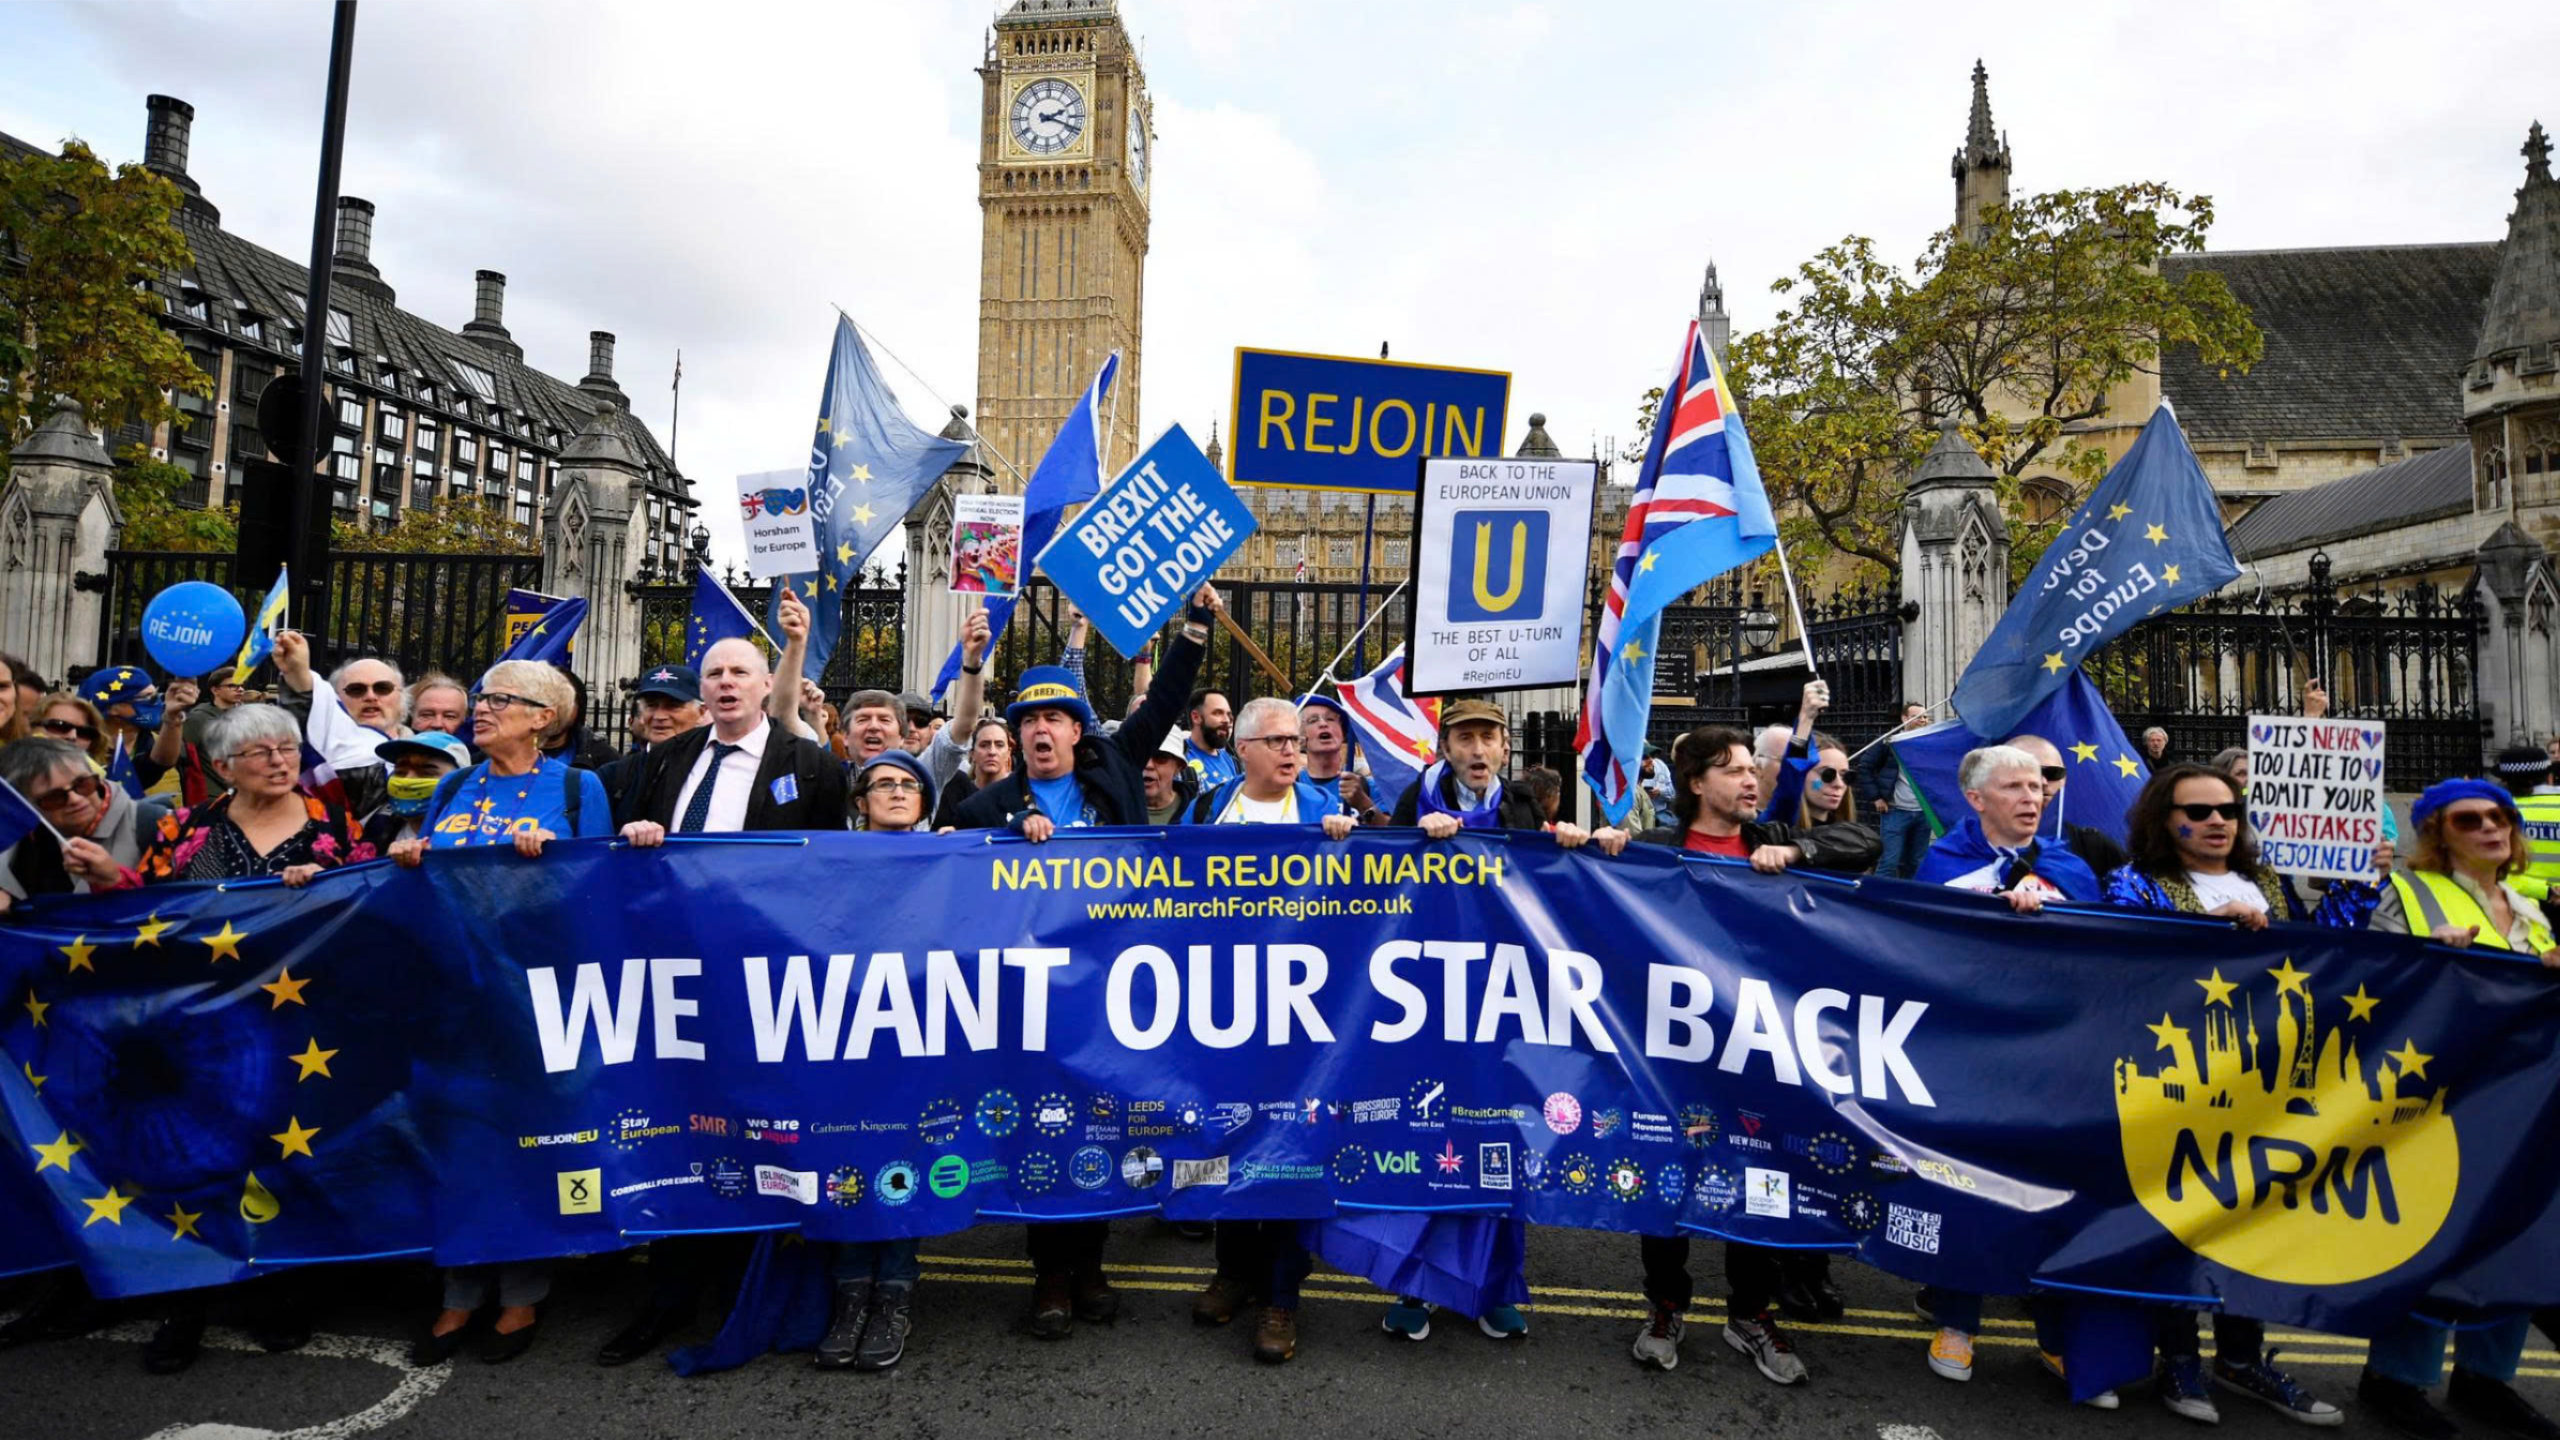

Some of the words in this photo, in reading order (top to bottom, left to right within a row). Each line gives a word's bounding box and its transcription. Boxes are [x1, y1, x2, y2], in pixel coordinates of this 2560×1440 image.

[1257, 389, 1485, 457] REJOIN
[1459, 464, 1498, 480] BACK
[1507, 465, 1526, 480] TO
[1529, 465, 1556, 480] THE
[1439, 484, 1521, 500] EUROPEAN
[1524, 485, 1572, 500] UNION
[988, 507, 1019, 516] ELECTION
[1077, 460, 1169, 559] BREXIT
[753, 525, 801, 538] Horsham
[1098, 530, 1158, 595] GOT
[1147, 482, 1207, 544] THE
[753, 544, 768, 554] for
[769, 540, 807, 552] Europe
[1117, 578, 1169, 629] UK
[1156, 509, 1234, 593] DONE
[149, 618, 213, 646] REJOIN
[1431, 631, 1460, 646] THE
[1467, 629, 1502, 644] BEST
[1508, 627, 1563, 644] U-TURN
[1468, 648, 1488, 662] OF
[1495, 647, 1520, 660] ALL
[1462, 668, 1522, 684] #RejoinEU
[2312, 725, 2362, 751] NEVER
[2252, 751, 2284, 776] TOO
[2288, 753, 2332, 780] LATE
[2339, 756, 2363, 782] TO
[2250, 781, 2315, 809] ADMIT
[2323, 786, 2377, 813] YOUR
[2268, 812, 2377, 844] MISTAKES
[991, 854, 1194, 890] NATIONAL
[1206, 853, 1352, 887] REJOIN
[1362, 851, 1504, 887] MARCH
[1086, 894, 1413, 921] www.MarchForRejoin.co.uk
[526, 957, 705, 1074] WE
[743, 946, 1071, 1063] WANT
[1105, 943, 1337, 1051] OUR
[1368, 938, 1619, 1054] STAR
[1644, 962, 1938, 1108] BACK
[1128, 1100, 1166, 1113] LEEDS
[1258, 1101, 1297, 1111] Scientists
[1352, 1097, 1401, 1113] GRASSROOTS
[1451, 1105, 1526, 1120] #BrexitCarnage
[620, 1116, 650, 1129] Stay
[1128, 1115, 1147, 1124] FOR
[1269, 1112, 1281, 1120] for
[1283, 1111, 1296, 1120] EU
[1354, 1111, 1369, 1124] FOR
[1370, 1108, 1399, 1122] EUROPE
[1632, 1111, 1669, 1122] European
[620, 1124, 681, 1140] European
[689, 1113, 728, 1135] SMR
[747, 1118, 769, 1128] we
[773, 1117, 800, 1131] are
[810, 1121, 857, 1134] Catharine
[1085, 1124, 1121, 1134] BREMAIN
[1128, 1125, 1174, 1137] EUROPE
[1632, 1122, 1673, 1133] Movement
[1095, 1132, 1121, 1141] Spain
[1631, 1132, 1674, 1143] Staffordshire
[1729, 1134, 1748, 1147] VIEW
[1749, 1138, 1773, 1151] DELTA
[1256, 1164, 1280, 1172] WALES
[1281, 1164, 1296, 1172] FOR
[1297, 1165, 1324, 1173] EUROPE
[1373, 1150, 1421, 1174] Volt
[1870, 1160, 1909, 1173] WOMEN
[759, 1170, 799, 1188] ISLINGTON
[2166, 1127, 2401, 1226] NRM
[610, 1179, 656, 1198] CORNWALL
[656, 1177, 674, 1187] FOR
[674, 1175, 705, 1185] EUROPE
[1797, 1183, 1816, 1193] East
[1817, 1188, 1838, 1201] Kent
[1696, 1193, 1709, 1201] FOR
[1797, 1194, 1810, 1202] for
[1797, 1205, 1828, 1217] Europe
[1888, 1213, 1914, 1232] FOR
[1916, 1221, 1941, 1238] THE
[1887, 1225, 1938, 1252] MUSIC
